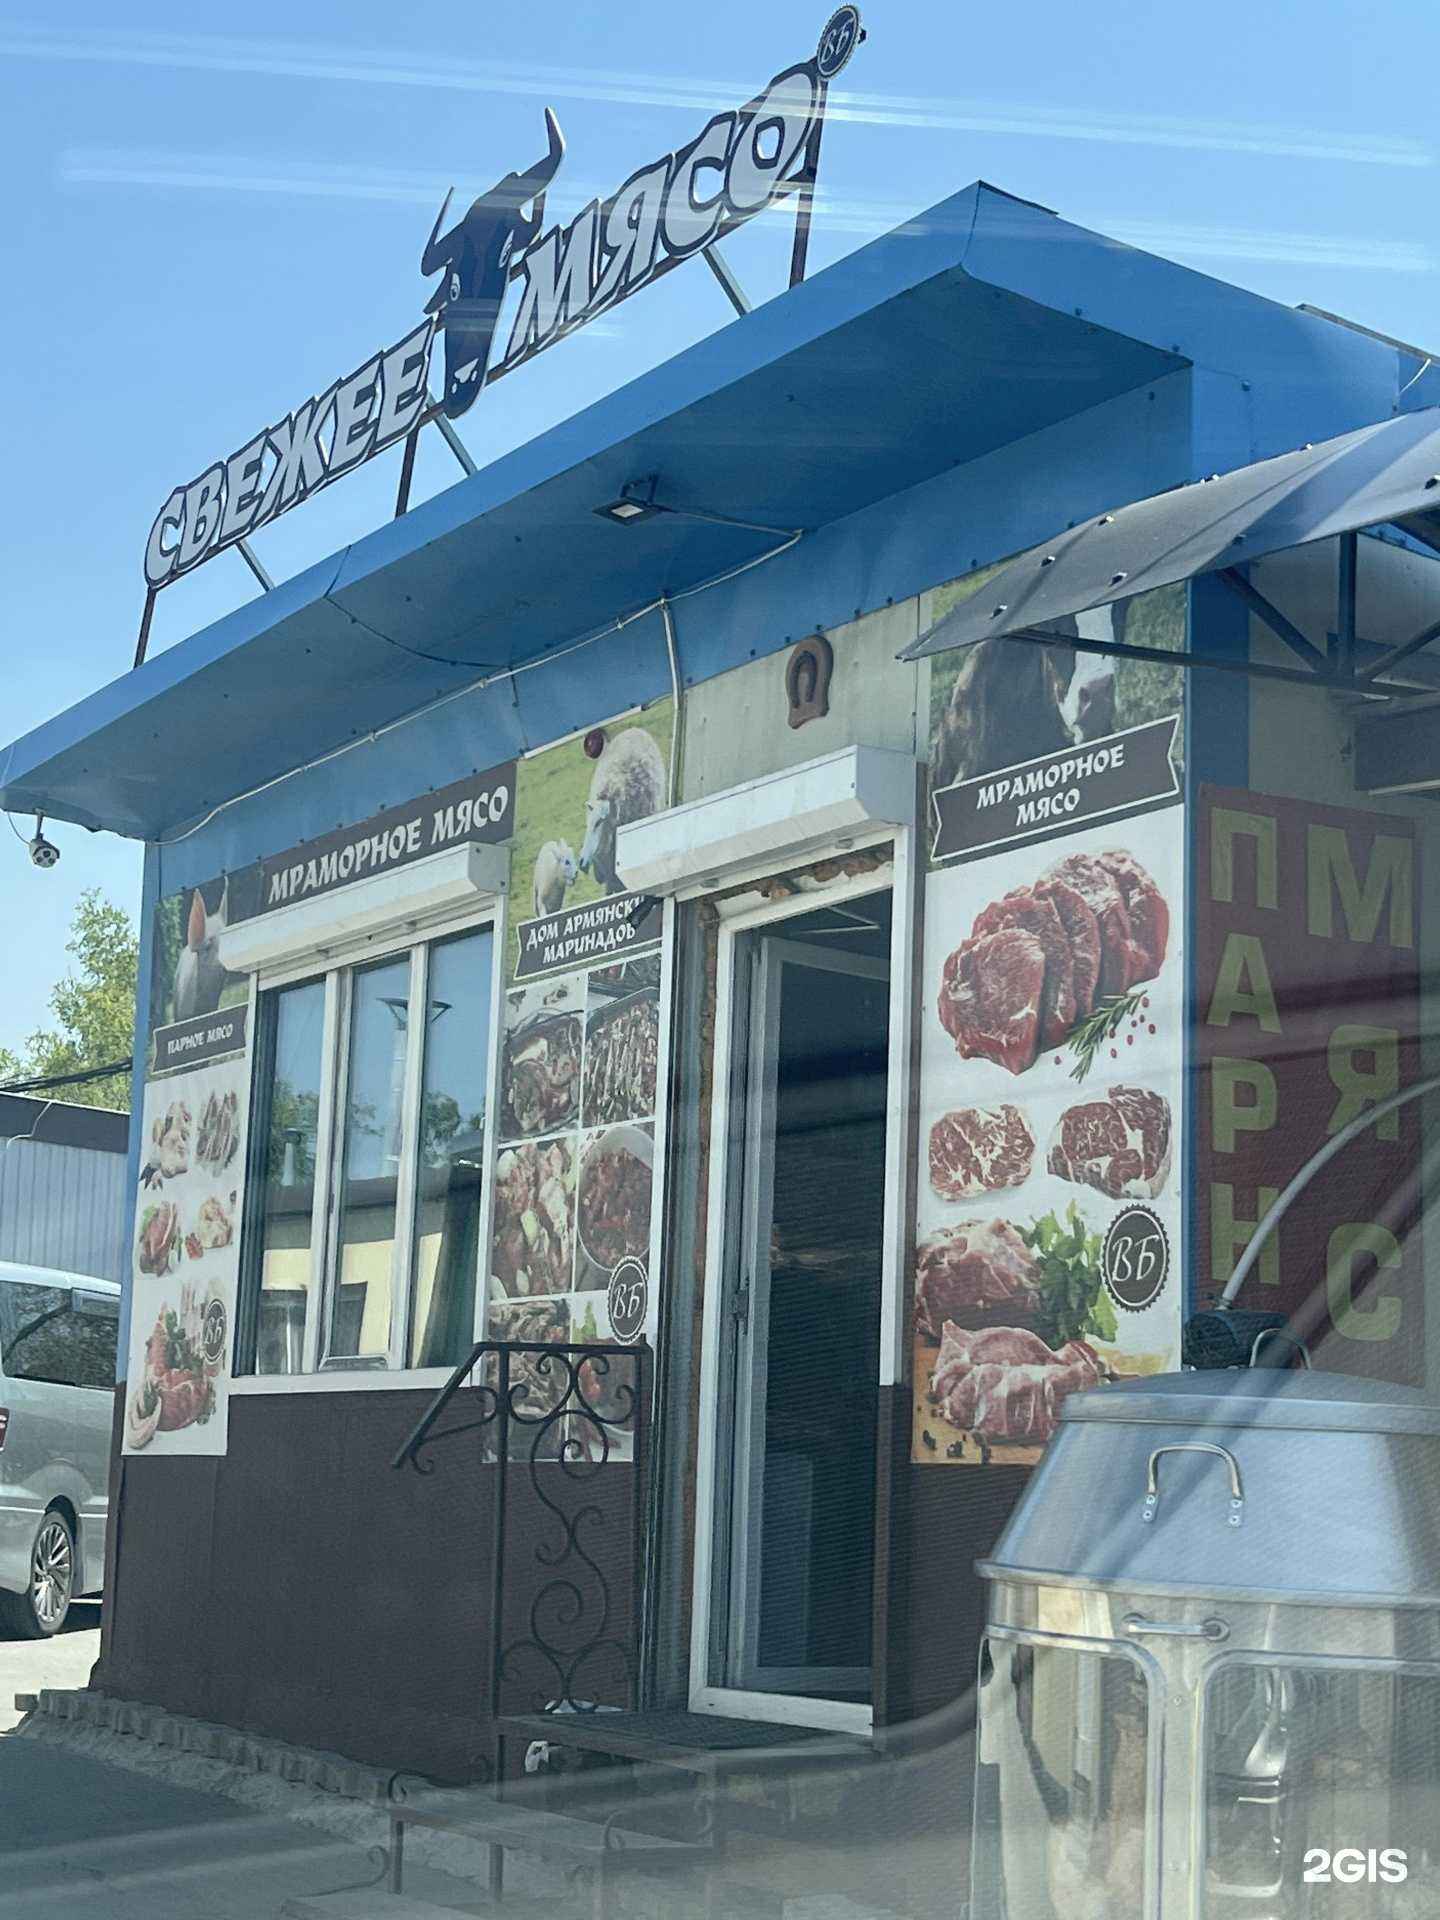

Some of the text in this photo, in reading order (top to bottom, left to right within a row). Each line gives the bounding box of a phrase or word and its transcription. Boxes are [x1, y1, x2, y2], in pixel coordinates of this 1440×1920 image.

[144, 65, 822, 587] СВЕЖЕЕ МЯСО
[976, 744, 1125, 810] МРАМОРНОЕ
[1016, 788, 1080, 827] МЯСО
[268, 784, 510, 904] МРАМОРНОЕ МЯСО
[526, 895, 645, 951] ДОМ АРМЯНСК
[167, 1023, 233, 1055] ПАРНОЕ МЯСО
[1206, 806, 1283, 1286] ПАРН
[1306, 822, 1414, 1342] МЯС
[1112, 1230, 1160, 1285] ВБ
[614, 1282, 643, 1319] ВБ
